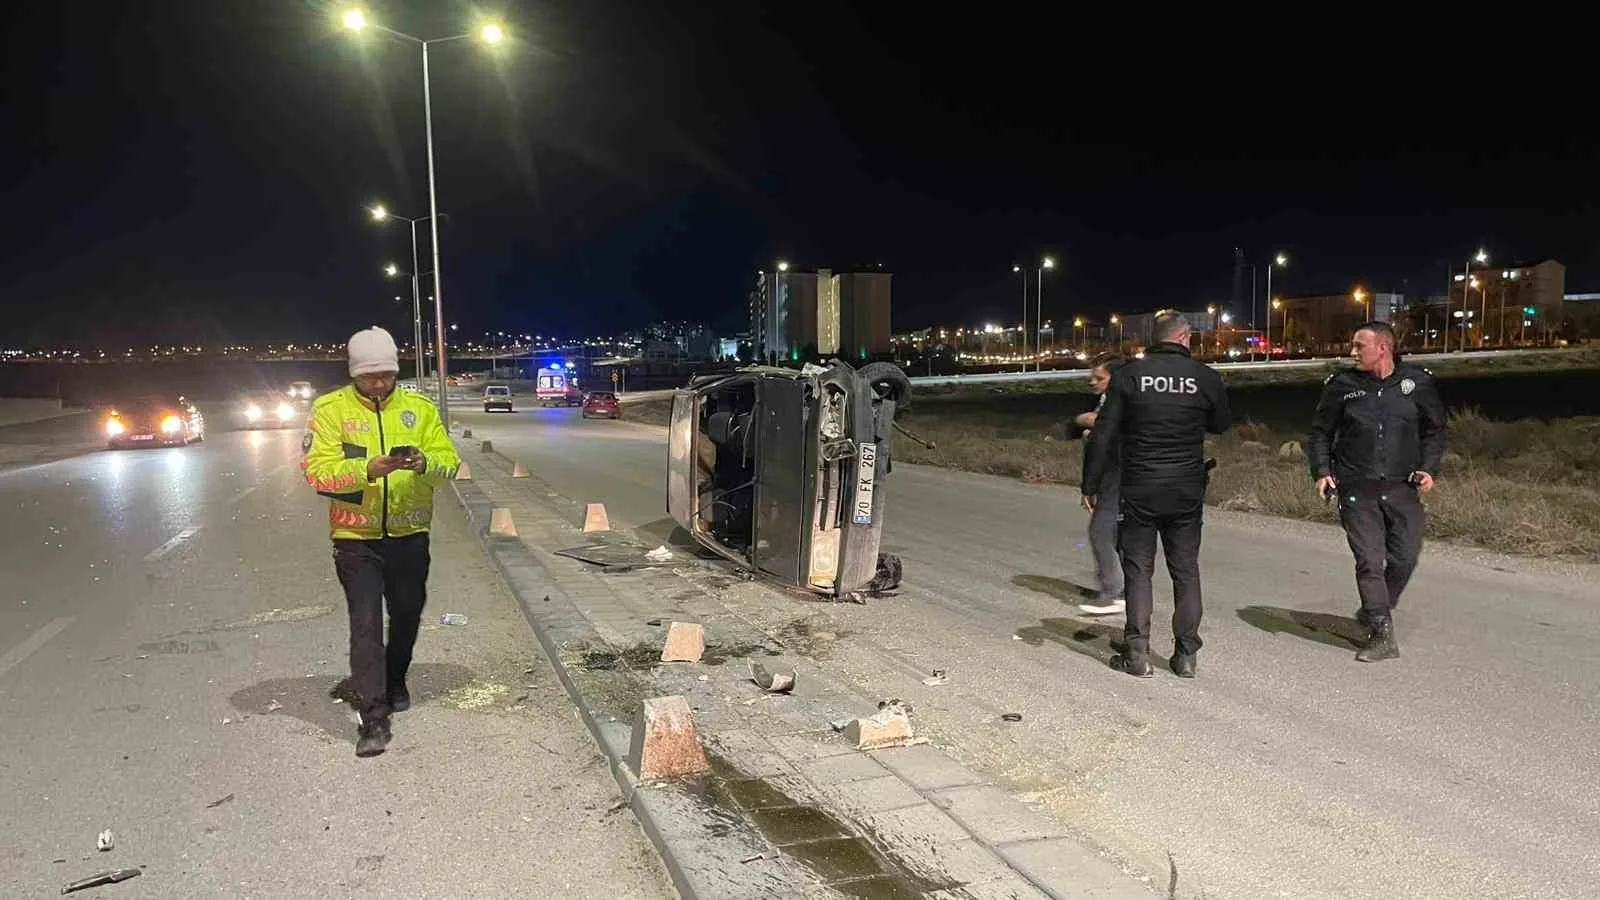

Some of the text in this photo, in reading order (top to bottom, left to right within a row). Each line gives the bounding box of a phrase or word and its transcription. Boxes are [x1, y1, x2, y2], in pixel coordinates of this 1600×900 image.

[862, 446, 875, 468] 267
[860, 478, 872, 492] FK
[858, 501, 870, 515] 70
